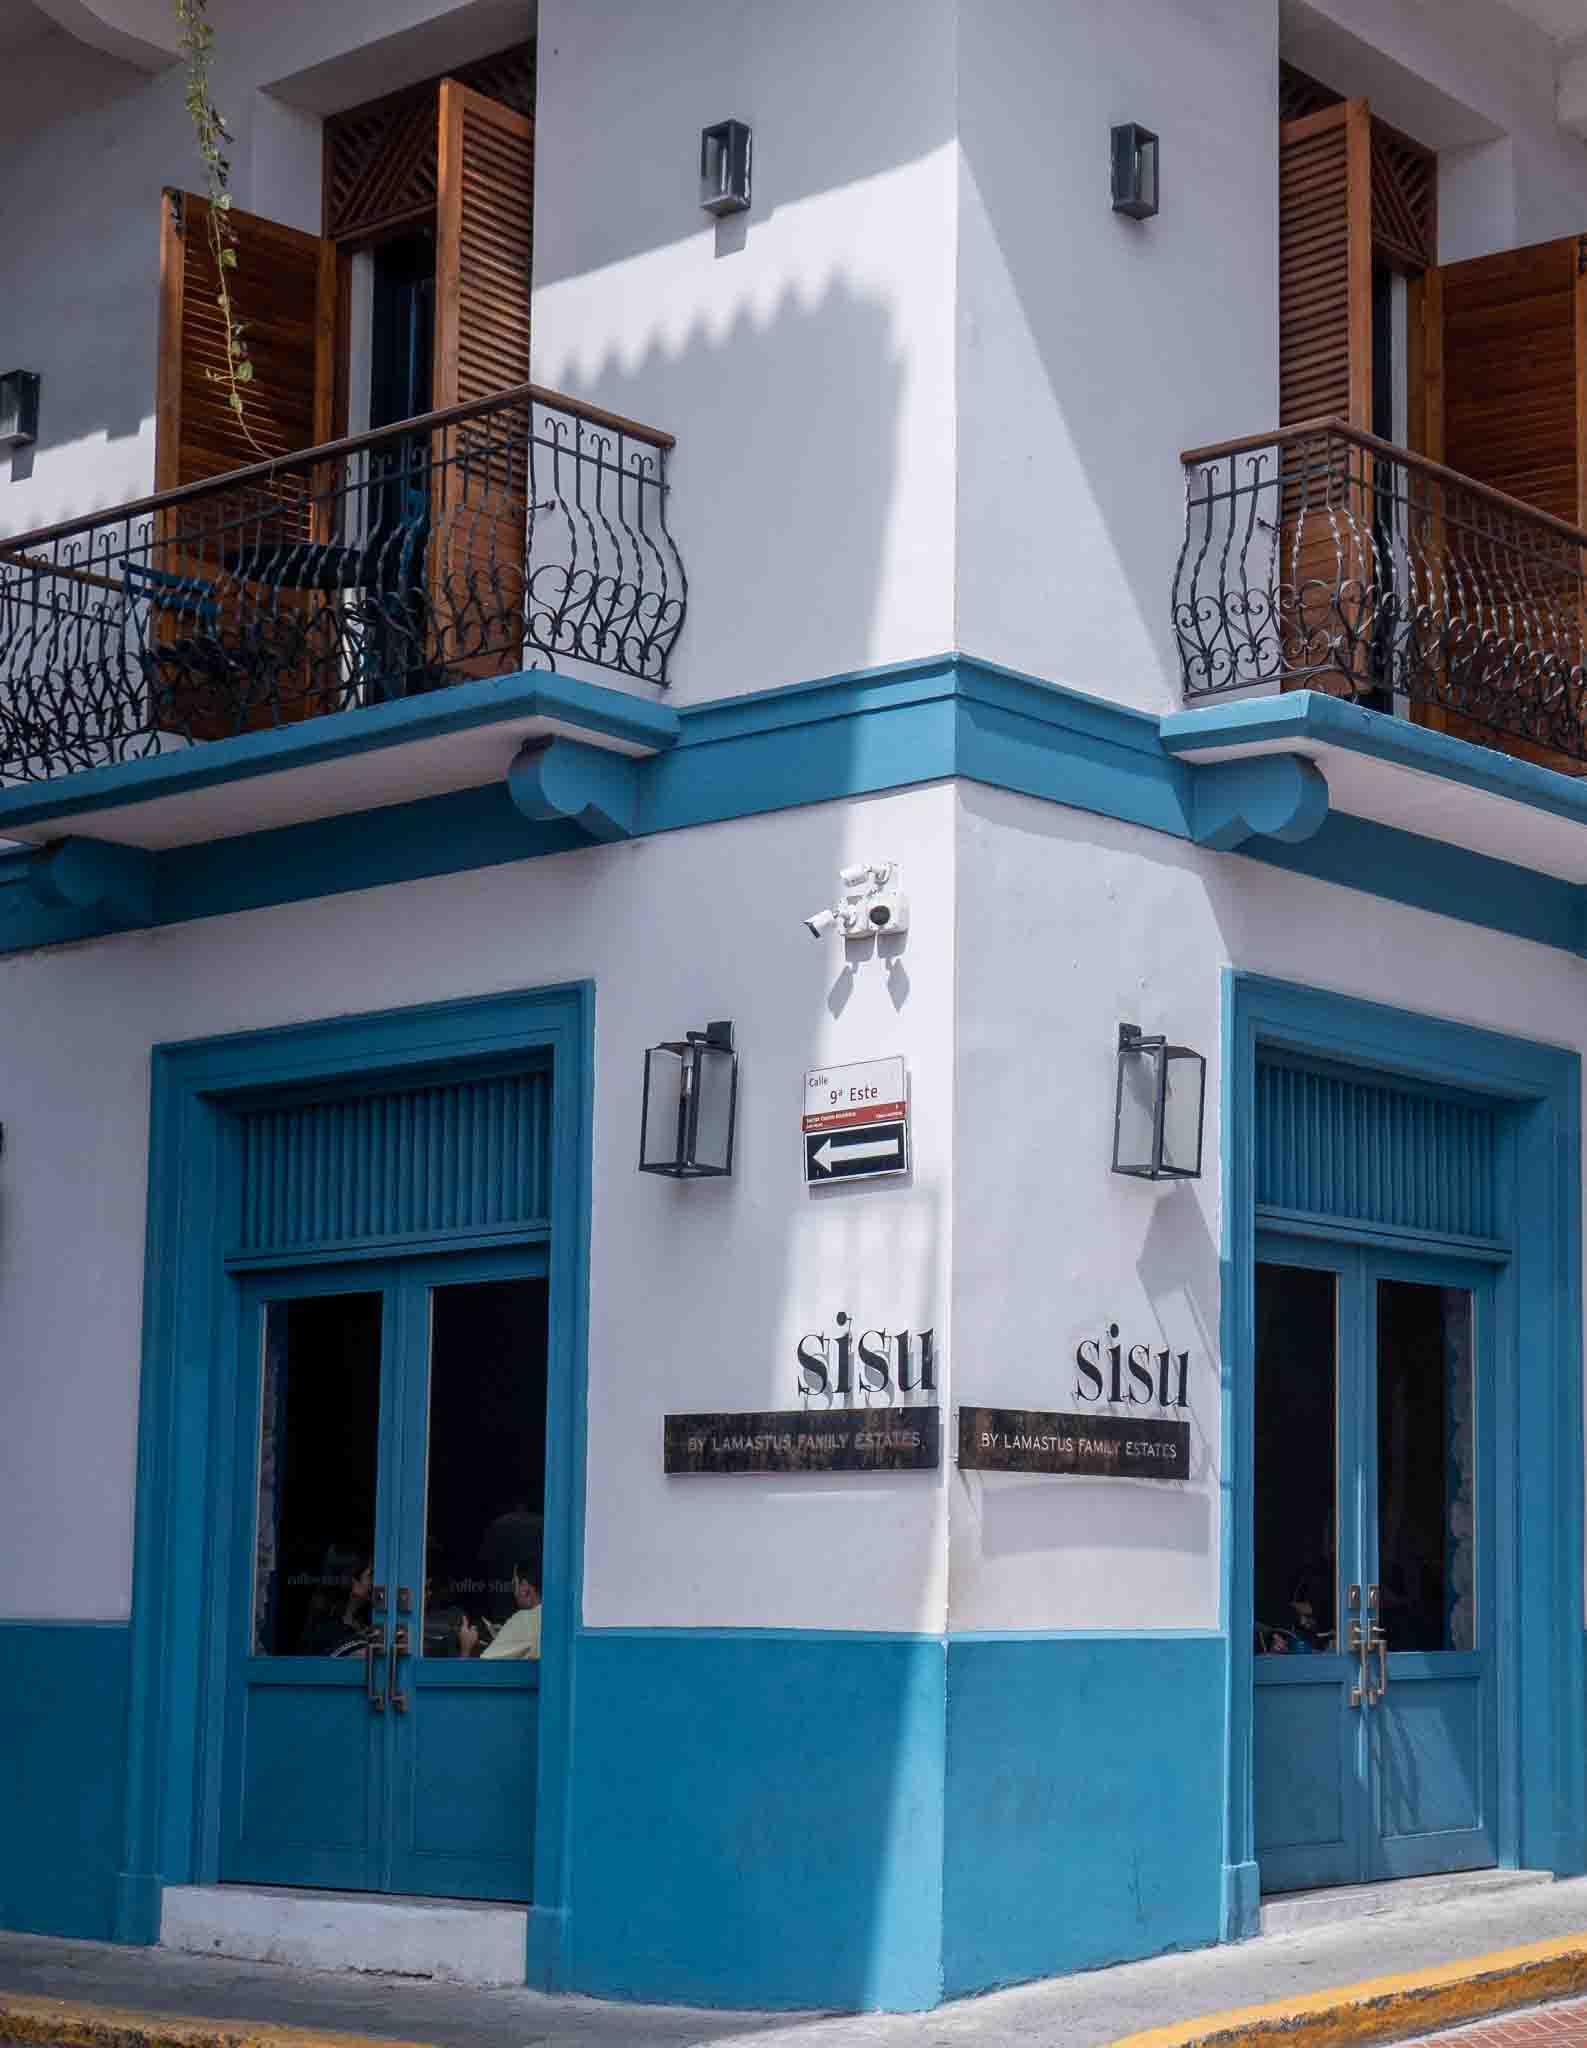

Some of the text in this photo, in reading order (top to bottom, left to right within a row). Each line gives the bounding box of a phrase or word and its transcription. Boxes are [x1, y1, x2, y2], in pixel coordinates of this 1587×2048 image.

[808, 1075, 828, 1088] Calle
[849, 1086, 878, 1102] Este
[797, 1312, 937, 1396] sisu
[1075, 1323, 1191, 1408] sisu
[687, 1430, 921, 1450] BY LAMASTUS FAMILY ESTATES
[981, 1432, 1177, 1459] BY LAMASTUS FAMILY ESTATES
